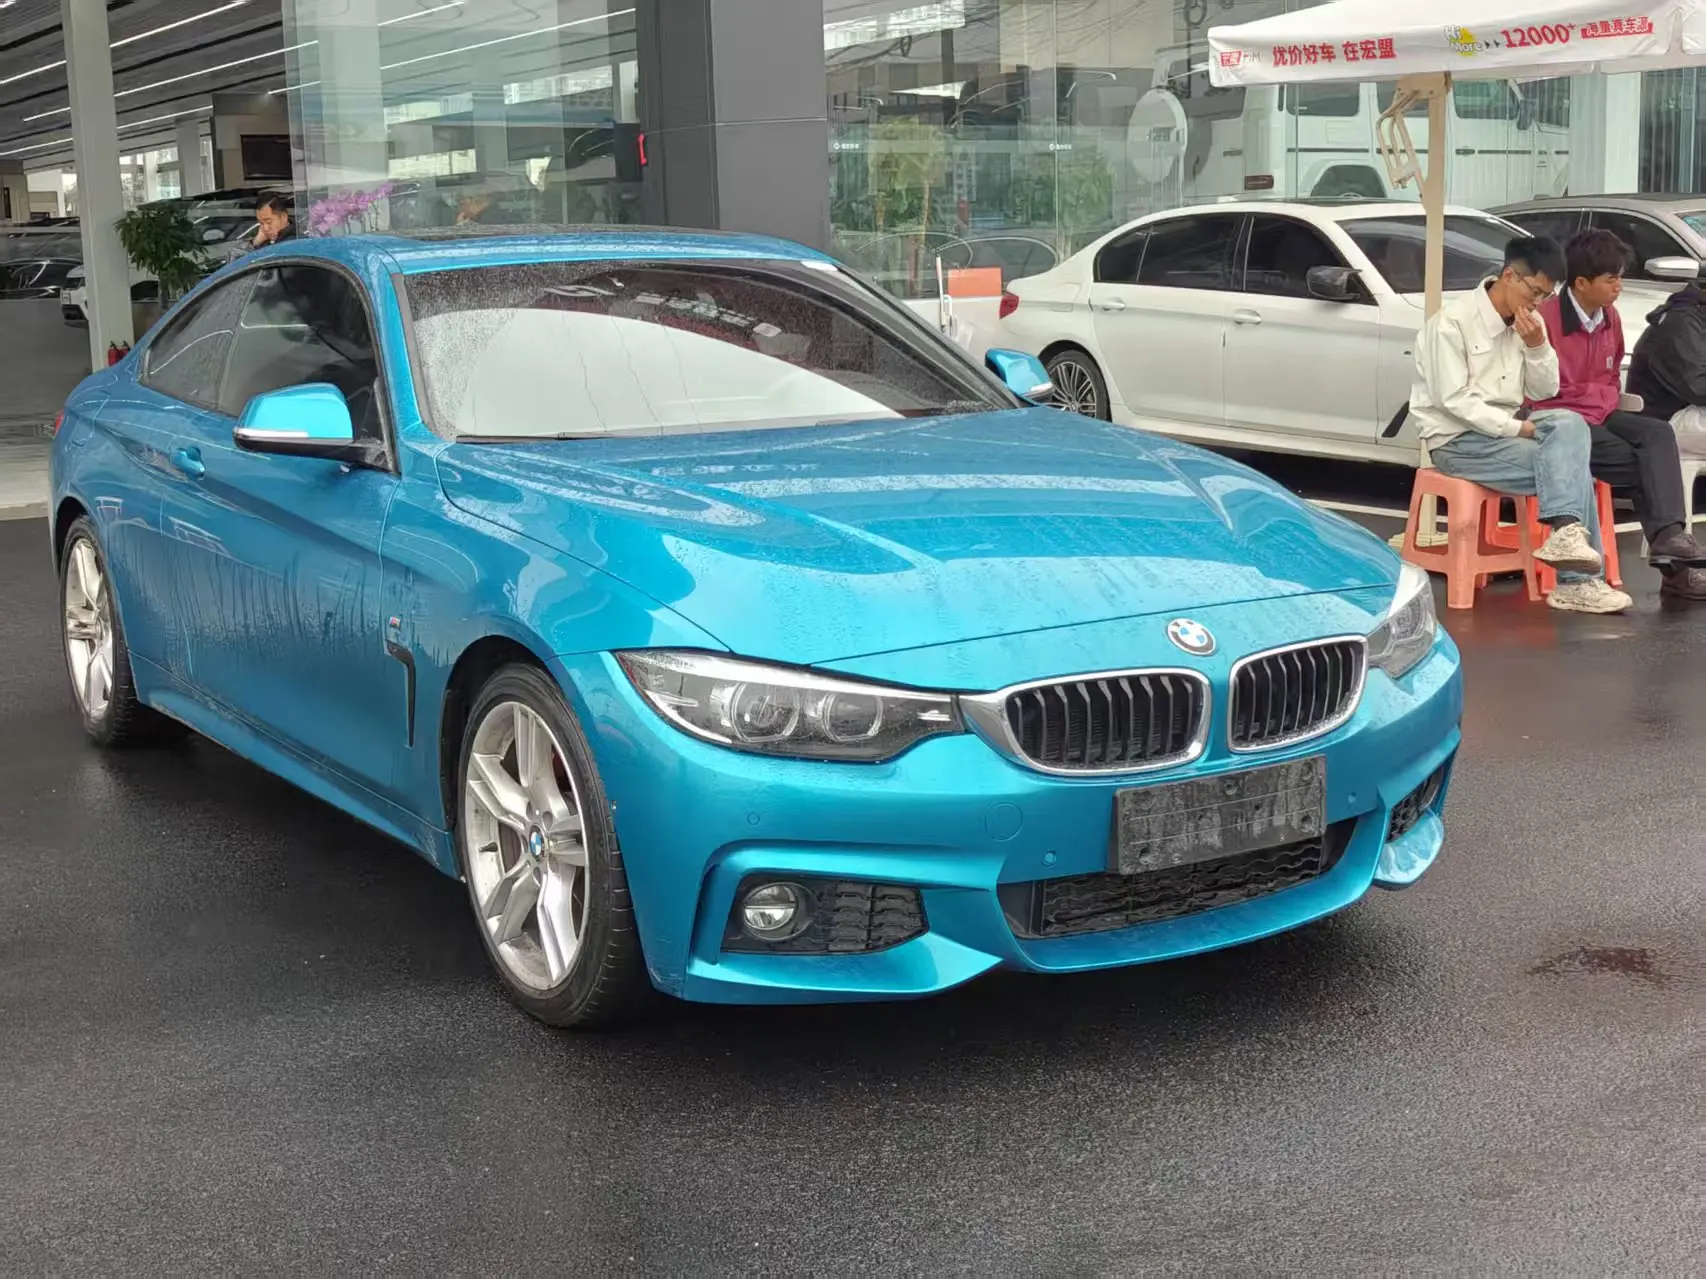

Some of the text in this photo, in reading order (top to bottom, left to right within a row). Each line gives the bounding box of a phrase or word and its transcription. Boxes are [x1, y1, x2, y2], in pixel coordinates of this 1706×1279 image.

[1272, 43, 1336, 67] 优价好车
[1342, 37, 1396, 62] 在宏盟
